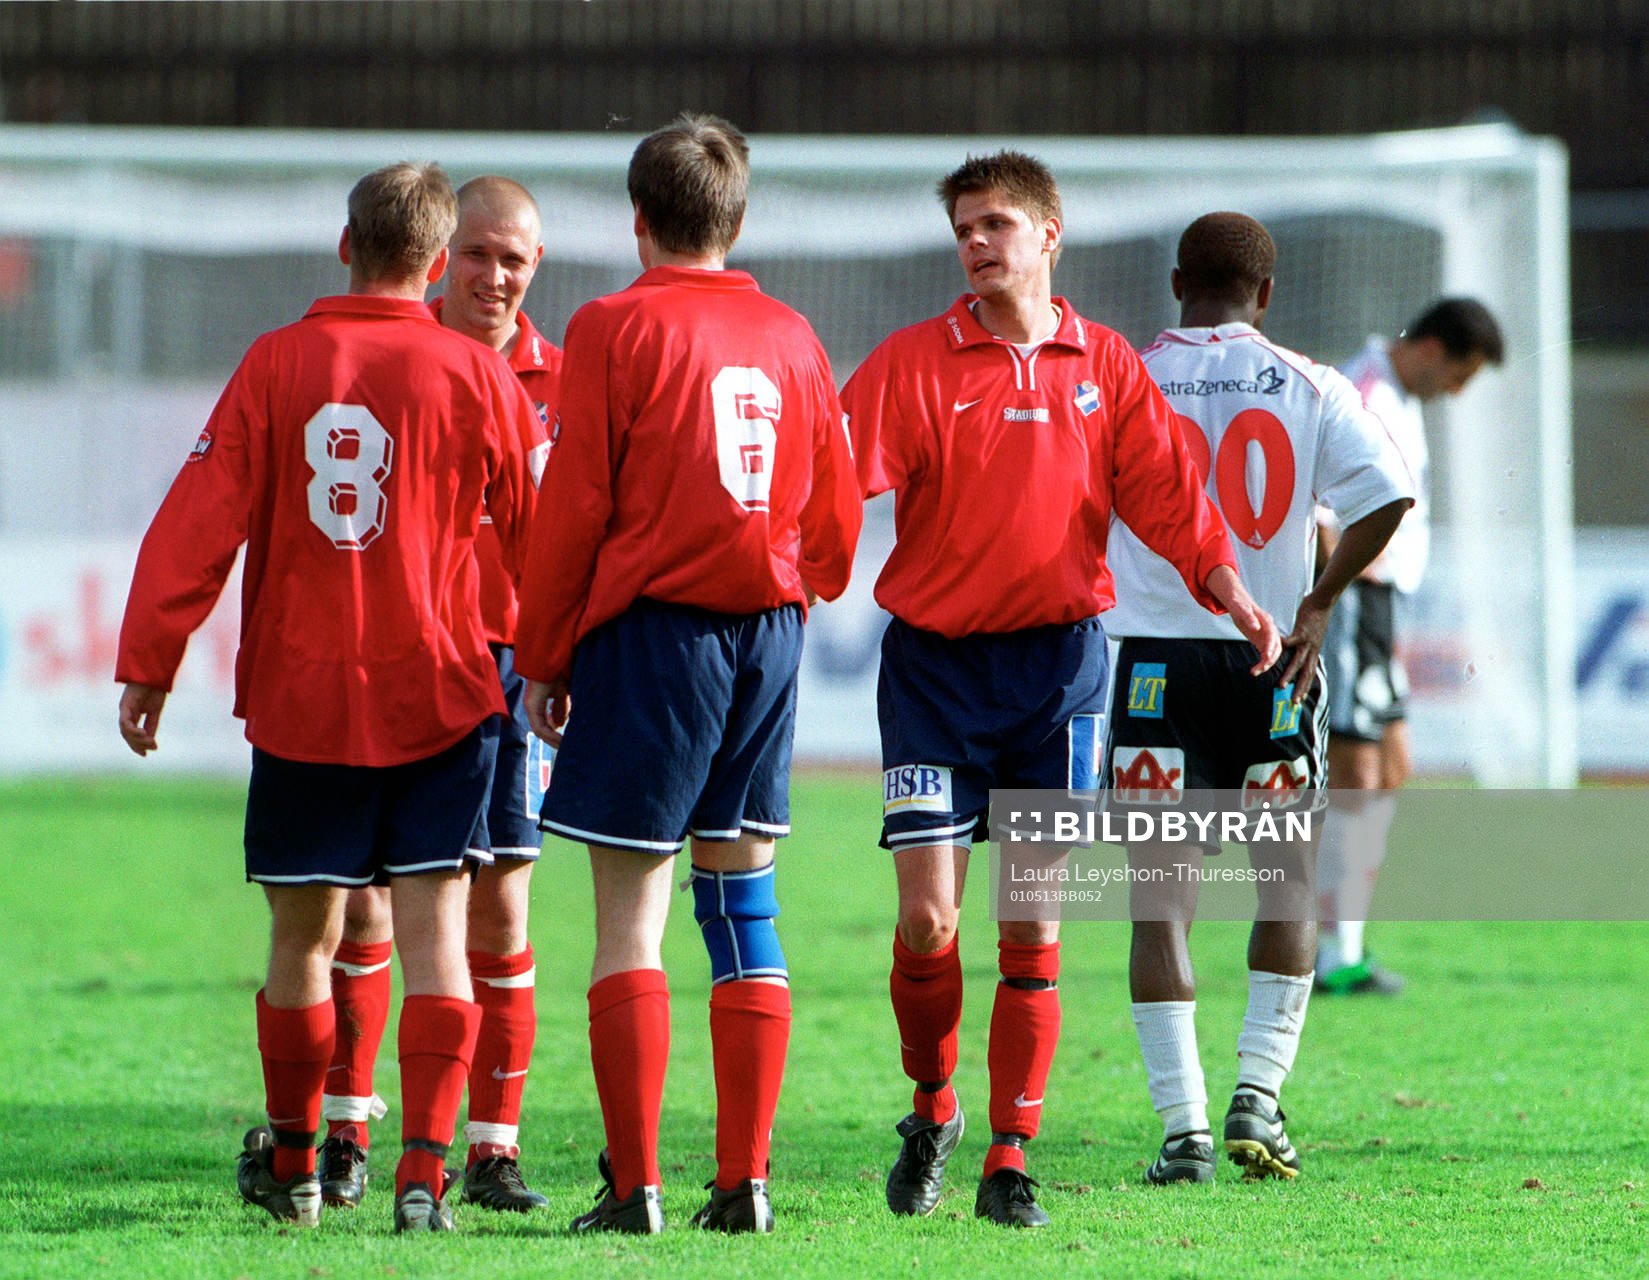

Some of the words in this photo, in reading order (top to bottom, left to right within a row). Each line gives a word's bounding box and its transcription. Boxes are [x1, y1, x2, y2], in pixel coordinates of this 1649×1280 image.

[1160, 378, 1259, 396] straZeneca
[1003, 407, 1049, 423] STADIU
[711, 366, 782, 513] 6
[304, 402, 393, 551] 8
[1127, 677, 1167, 711] LT
[1269, 700, 1303, 733] LT
[886, 768, 942, 800] HSB
[1114, 750, 1181, 801] MAX
[1243, 762, 1307, 808] MAX
